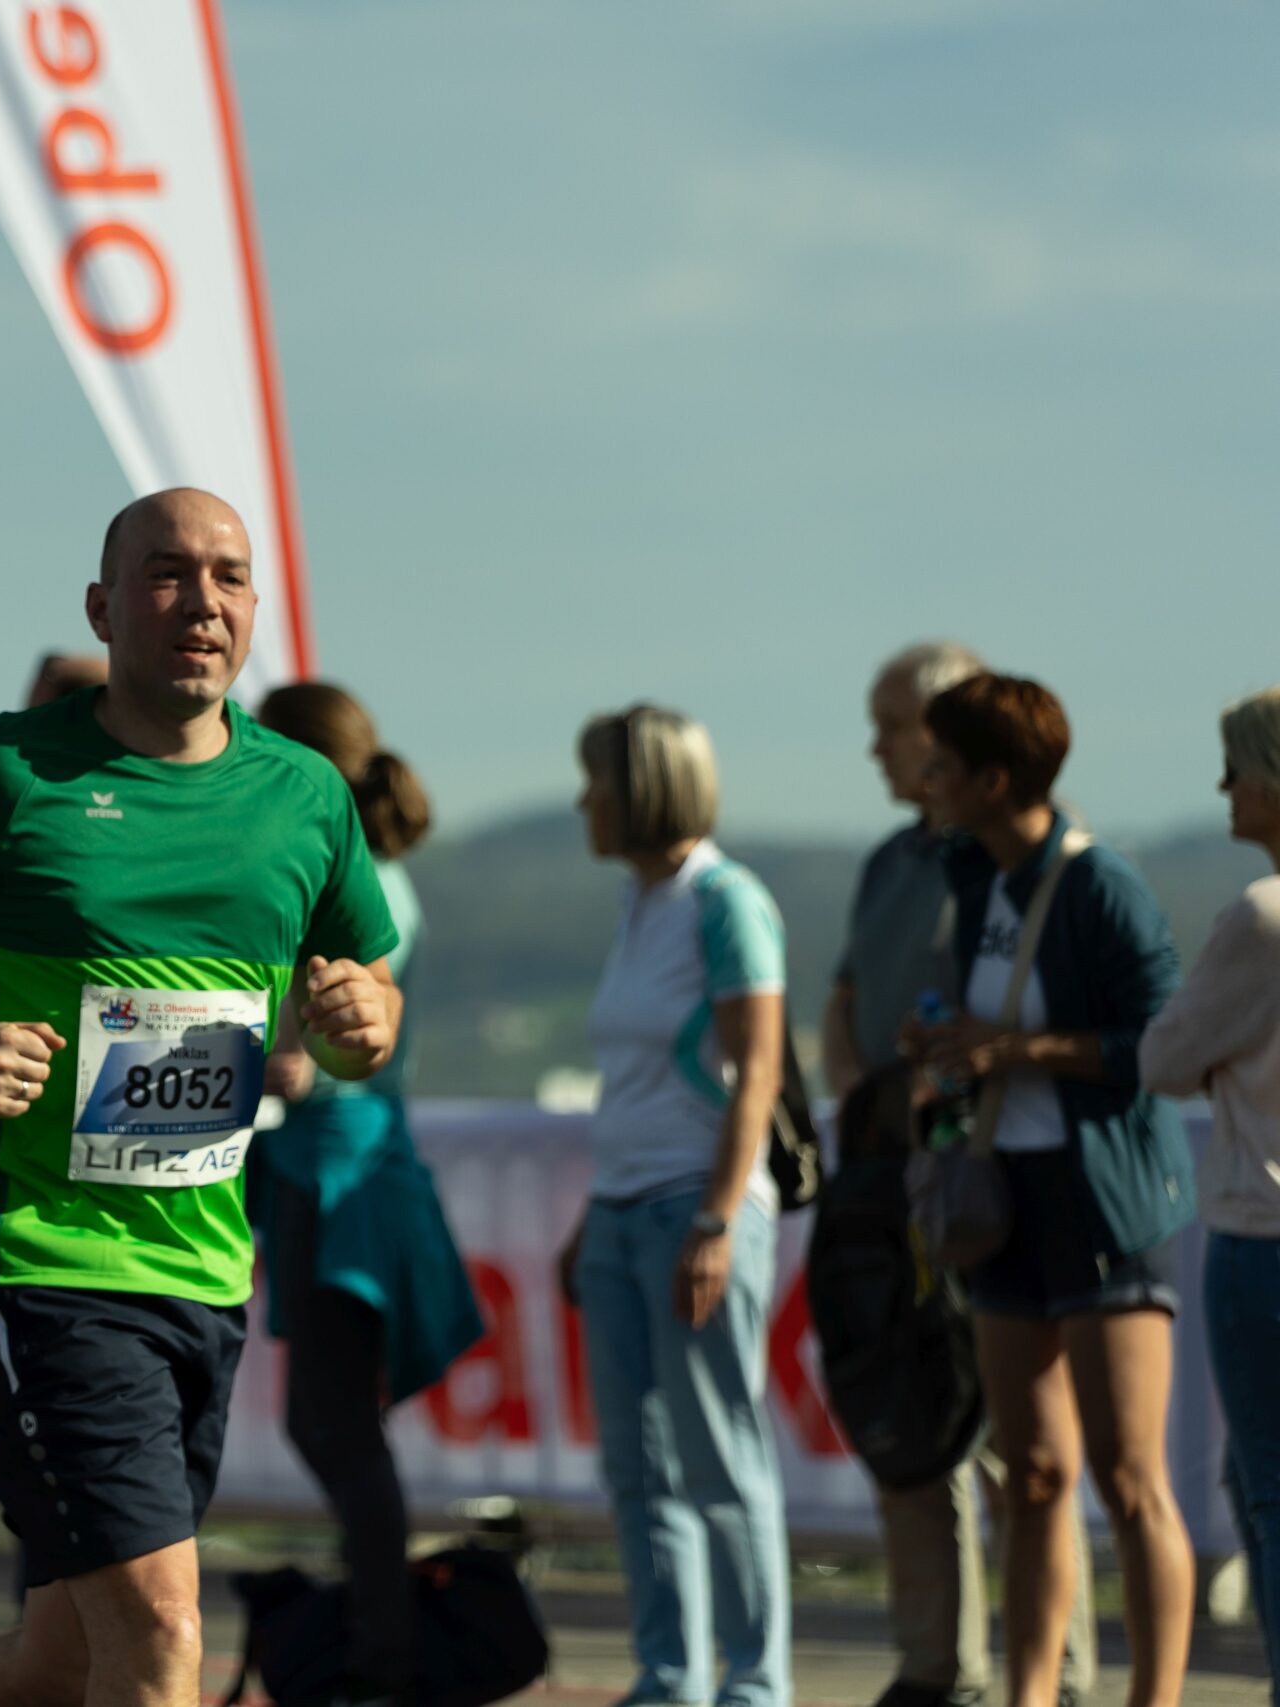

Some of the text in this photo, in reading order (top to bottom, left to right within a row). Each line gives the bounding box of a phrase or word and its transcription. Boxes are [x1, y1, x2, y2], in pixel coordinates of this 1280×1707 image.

[168, 1047, 209, 1060] Niklas
[124, 1064, 233, 1110] 8052
[199, 1146, 239, 1172] AG
